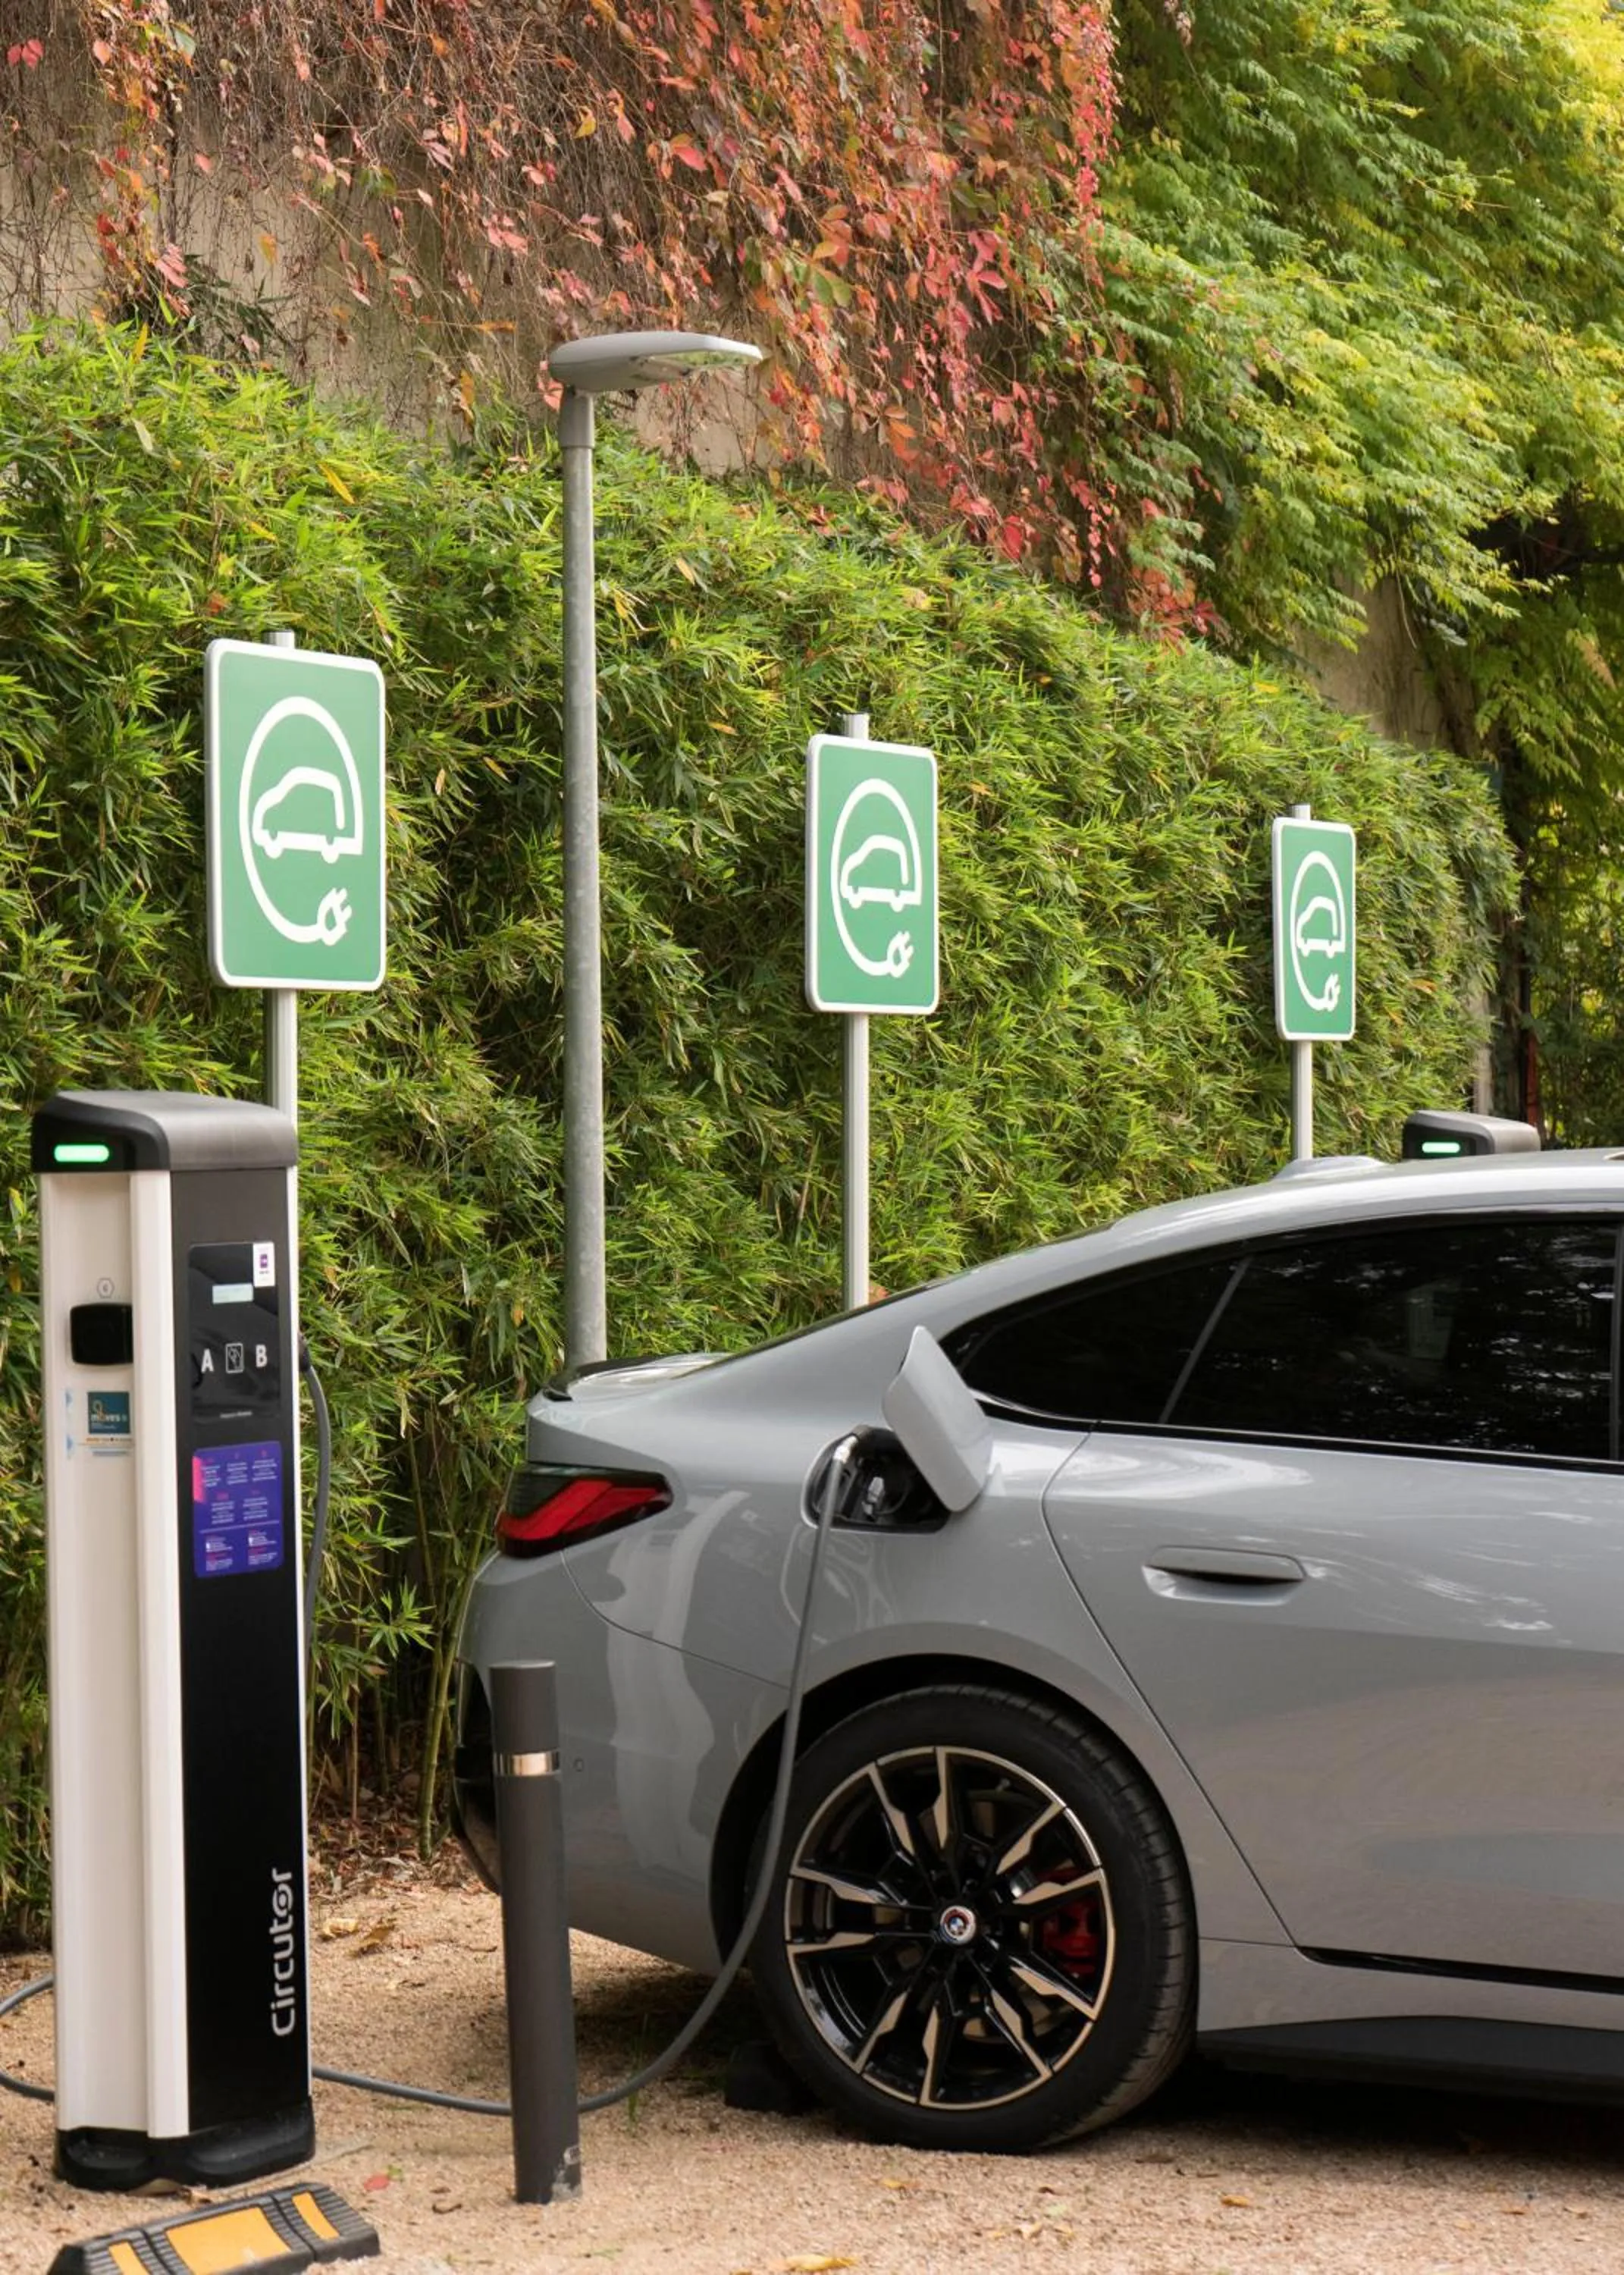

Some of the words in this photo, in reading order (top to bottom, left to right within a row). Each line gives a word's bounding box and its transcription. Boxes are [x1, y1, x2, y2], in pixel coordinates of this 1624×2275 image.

[201, 1349, 214, 1373] A
[256, 1345, 267, 1367] B
[269, 1868, 295, 2036] Circutor
